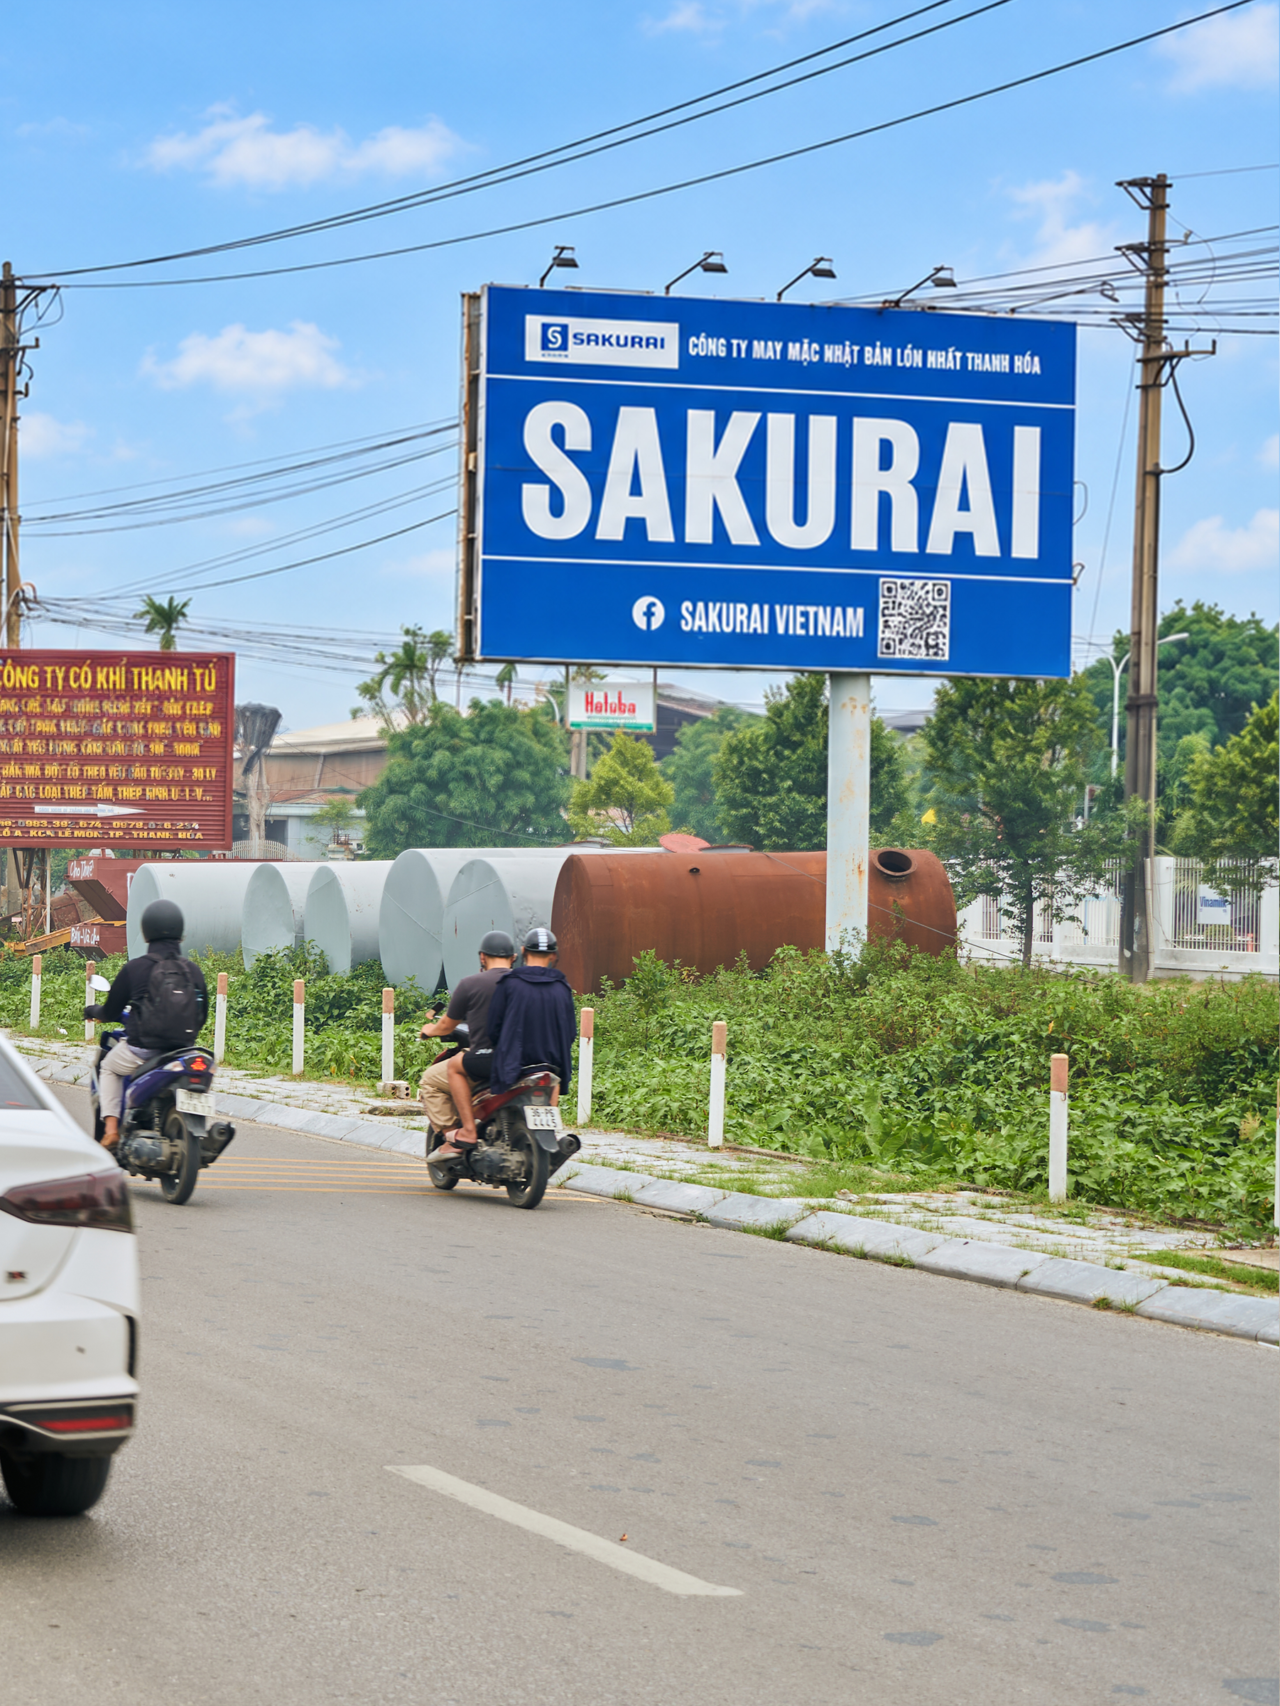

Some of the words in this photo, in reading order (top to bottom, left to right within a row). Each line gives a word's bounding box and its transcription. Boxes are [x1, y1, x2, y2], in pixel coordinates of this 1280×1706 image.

[572, 332, 665, 350] SAKURAI
[688, 333, 726, 358] CÔNG
[731, 337, 748, 359] TY
[752, 340, 783, 361] MAY
[787, 339, 819, 366] MẶC
[824, 340, 860, 368] NHẬT
[864, 341, 892, 367] BẢN
[966, 352, 1010, 374] THANH
[521, 400, 1042, 560] SAKURAI
[680, 600, 770, 634] SAKURAI
[775, 604, 865, 638] VIETNAM
[43, 666, 65, 691] TY
[131, 666, 188, 692] THANH
[585, 690, 636, 716] Hatuba
[83, 765, 106, 779] THEO
